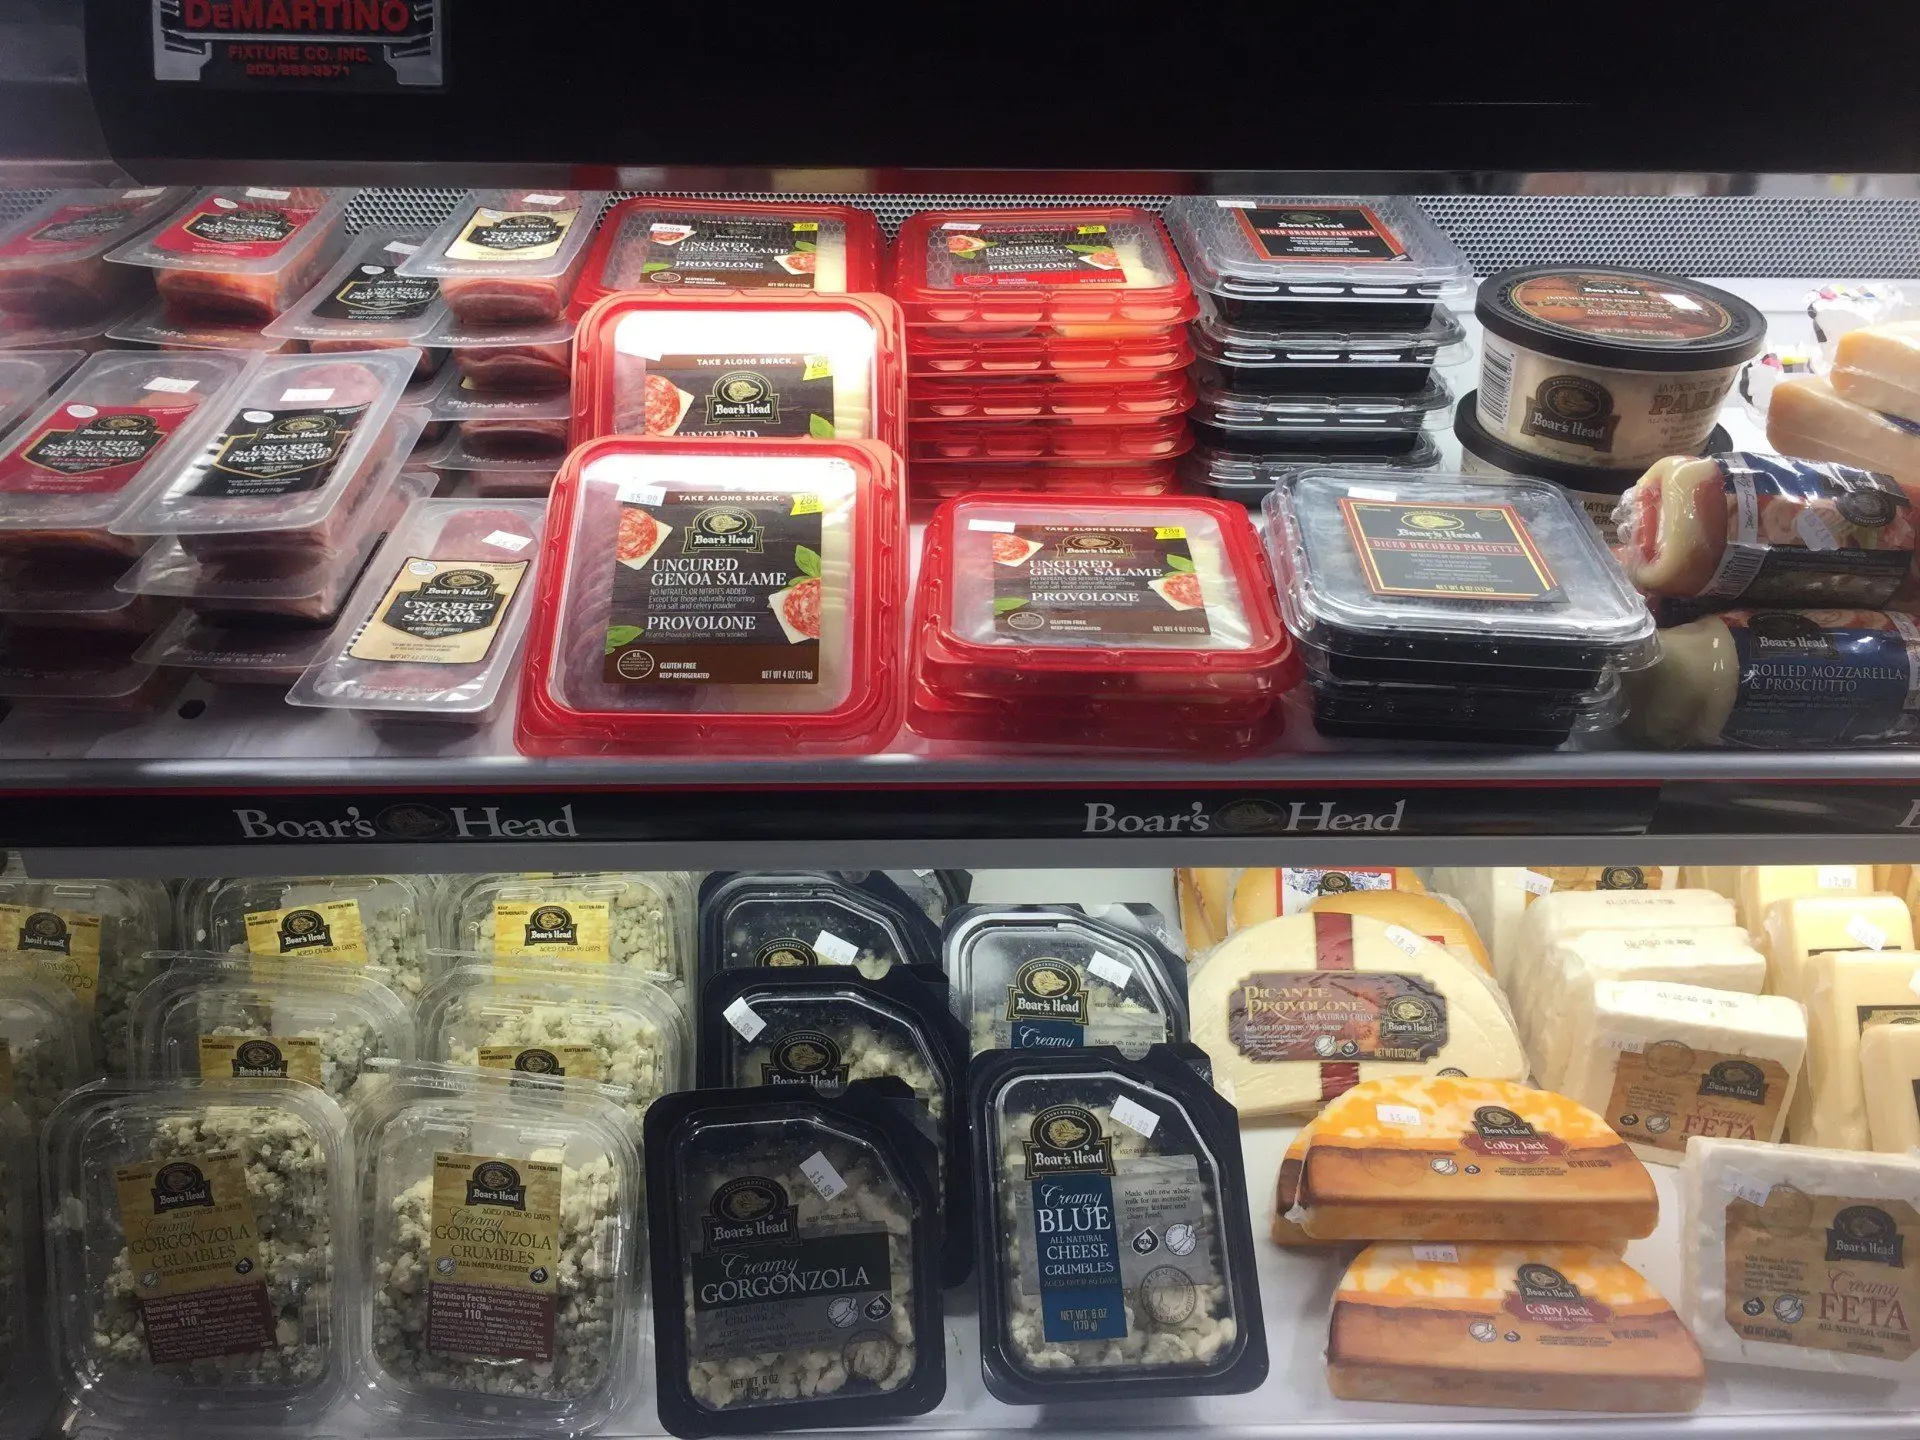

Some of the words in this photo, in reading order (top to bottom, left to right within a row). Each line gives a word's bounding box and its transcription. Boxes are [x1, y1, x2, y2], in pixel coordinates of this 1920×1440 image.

[227, 44, 299, 61] FIXTURE
[1259, 228, 1287, 236] DICED
[732, 247, 789, 255] SALAME
[986, 250, 1074, 258] SOPRESSATA
[674, 260, 765, 269] PROVOLONE
[988, 263, 1077, 271] PROVOLONE
[696, 358, 721, 366] TAKE
[724, 358, 757, 366] ALONG
[759, 358, 792, 366] SNACK
[715, 403, 744, 415] Boar's
[746, 402, 771, 415] Head
[1532, 410, 1569, 433] Boar's
[1572, 421, 1605, 439] Head
[117, 428, 147, 437] Head
[263, 432, 299, 441] Boar's
[300, 430, 329, 440] Head
[251, 442, 325, 451] UNCURED
[227, 455, 260, 463] DRY
[799, 493, 819, 505] 289
[694, 533, 726, 545] Boar's
[728, 533, 755, 546] Head
[1397, 528, 1446, 539] Boar's
[1448, 529, 1483, 540] Head
[1066, 547, 1098, 555] Boar's
[1098, 547, 1125, 555] Head
[1373, 539, 1406, 550] DICED
[1409, 541, 1461, 552] UNCURED
[1464, 543, 1521, 554] PANCETTA
[652, 558, 739, 572] UNCURED
[1029, 560, 1113, 568] UNCURED
[651, 571, 711, 586] GENOA
[716, 572, 787, 586] SALAME
[1029, 568, 1090, 577] GENOA
[1093, 568, 1163, 577] SALAME
[426, 586, 460, 597] Boar's
[461, 586, 489, 598] Head
[1031, 592, 1140, 602] PROVOLONE
[403, 600, 495, 611] UNCURED
[698, 595, 727, 604] naturally
[401, 614, 483, 625] SALAME
[413, 608, 477, 617] GENOA
[646, 615, 756, 630] PROVOLONE
[1758, 636, 1798, 649] Boar's
[1799, 636, 1829, 649] Head
[660, 662, 682, 670] GLUTEN
[682, 662, 697, 670] FREE
[1751, 663, 1808, 678] ROLLED
[1811, 665, 1904, 681] MOZZARELLA
[673, 672, 710, 680] REFRIGERATED
[1750, 679, 1760, 690] &
[1765, 678, 1858, 693] PROSCIUTTO
[232, 806, 377, 839] Boar's
[450, 803, 580, 839] Head
[1082, 801, 1210, 833] Boar's
[1282, 798, 1407, 832] Head
[284, 935, 307, 946] Boar's
[308, 932, 326, 942] Head
[531, 930, 554, 940] Boar's
[554, 929, 572, 939] Head
[1243, 986, 1332, 1003] PICANTE
[1016, 997, 1051, 1013] Boar's
[1052, 998, 1080, 1014] Head
[1250, 998, 1367, 1018] PROVOLONE
[1315, 1012, 1349, 1021] NATURAL
[1387, 1022, 1412, 1033] Boar's
[1412, 1023, 1434, 1033] Head
[1019, 1025, 1075, 1048] Creamy
[810, 1074, 839, 1089] Head
[1707, 1081, 1735, 1094] Boar's
[1736, 1084, 1760, 1097] Head
[1483, 1125, 1510, 1136] Boar's
[1510, 1126, 1531, 1137] Head
[1683, 1114, 1756, 1140] FETA
[1484, 1140, 1520, 1153] Colby
[1520, 1140, 1550, 1150] Jack
[1034, 1151, 1071, 1167] Boar's
[1073, 1149, 1104, 1164] Head
[809, 1170, 834, 1199] $5.99
[159, 1192, 185, 1206] Boar's
[186, 1189, 206, 1202] Head
[472, 1188, 499, 1201] Boar's
[499, 1189, 520, 1202] Head
[1040, 1184, 1103, 1212] Creamy
[1124, 1189, 1142, 1197] Made
[449, 1206, 505, 1231] Creamy
[481, 1207, 503, 1216] AGED
[502, 1210, 524, 1218] OVER
[533, 1213, 551, 1221] DAYS
[1036, 1207, 1112, 1234] BLUE
[140, 1218, 198, 1238] Creamy
[713, 1221, 753, 1242] Boar's
[756, 1216, 788, 1235] Head
[131, 1224, 252, 1256] GORGONZOLA
[434, 1225, 552, 1251] GORGONZOLA
[1049, 1236, 1066, 1244] ALL
[1067, 1234, 1104, 1243] NATURAL
[1046, 1243, 1109, 1260] CHEESE
[1835, 1239, 1868, 1255] Boar's
[1868, 1241, 1895, 1256] Head
[151, 1244, 238, 1269] CRUMBLES
[450, 1245, 536, 1265] CRUMBLES
[471, 1262, 502, 1270] NATURAL
[502, 1265, 530, 1273] CHEESE
[720, 1253, 799, 1284] Creamy
[1044, 1261, 1115, 1277] CRUMBLES
[700, 1266, 870, 1304] GORGONZOLA
[1827, 1268, 1900, 1300] Creamy
[1526, 1287, 1552, 1298] Boar's
[1552, 1288, 1575, 1299] Head
[431, 1308, 463, 1319] Calories
[1525, 1303, 1563, 1317] Colby
[1564, 1305, 1593, 1316] Jack
[1818, 1291, 1911, 1332] FETA
[148, 1321, 180, 1332] Calories
[180, 1316, 198, 1328] 110
